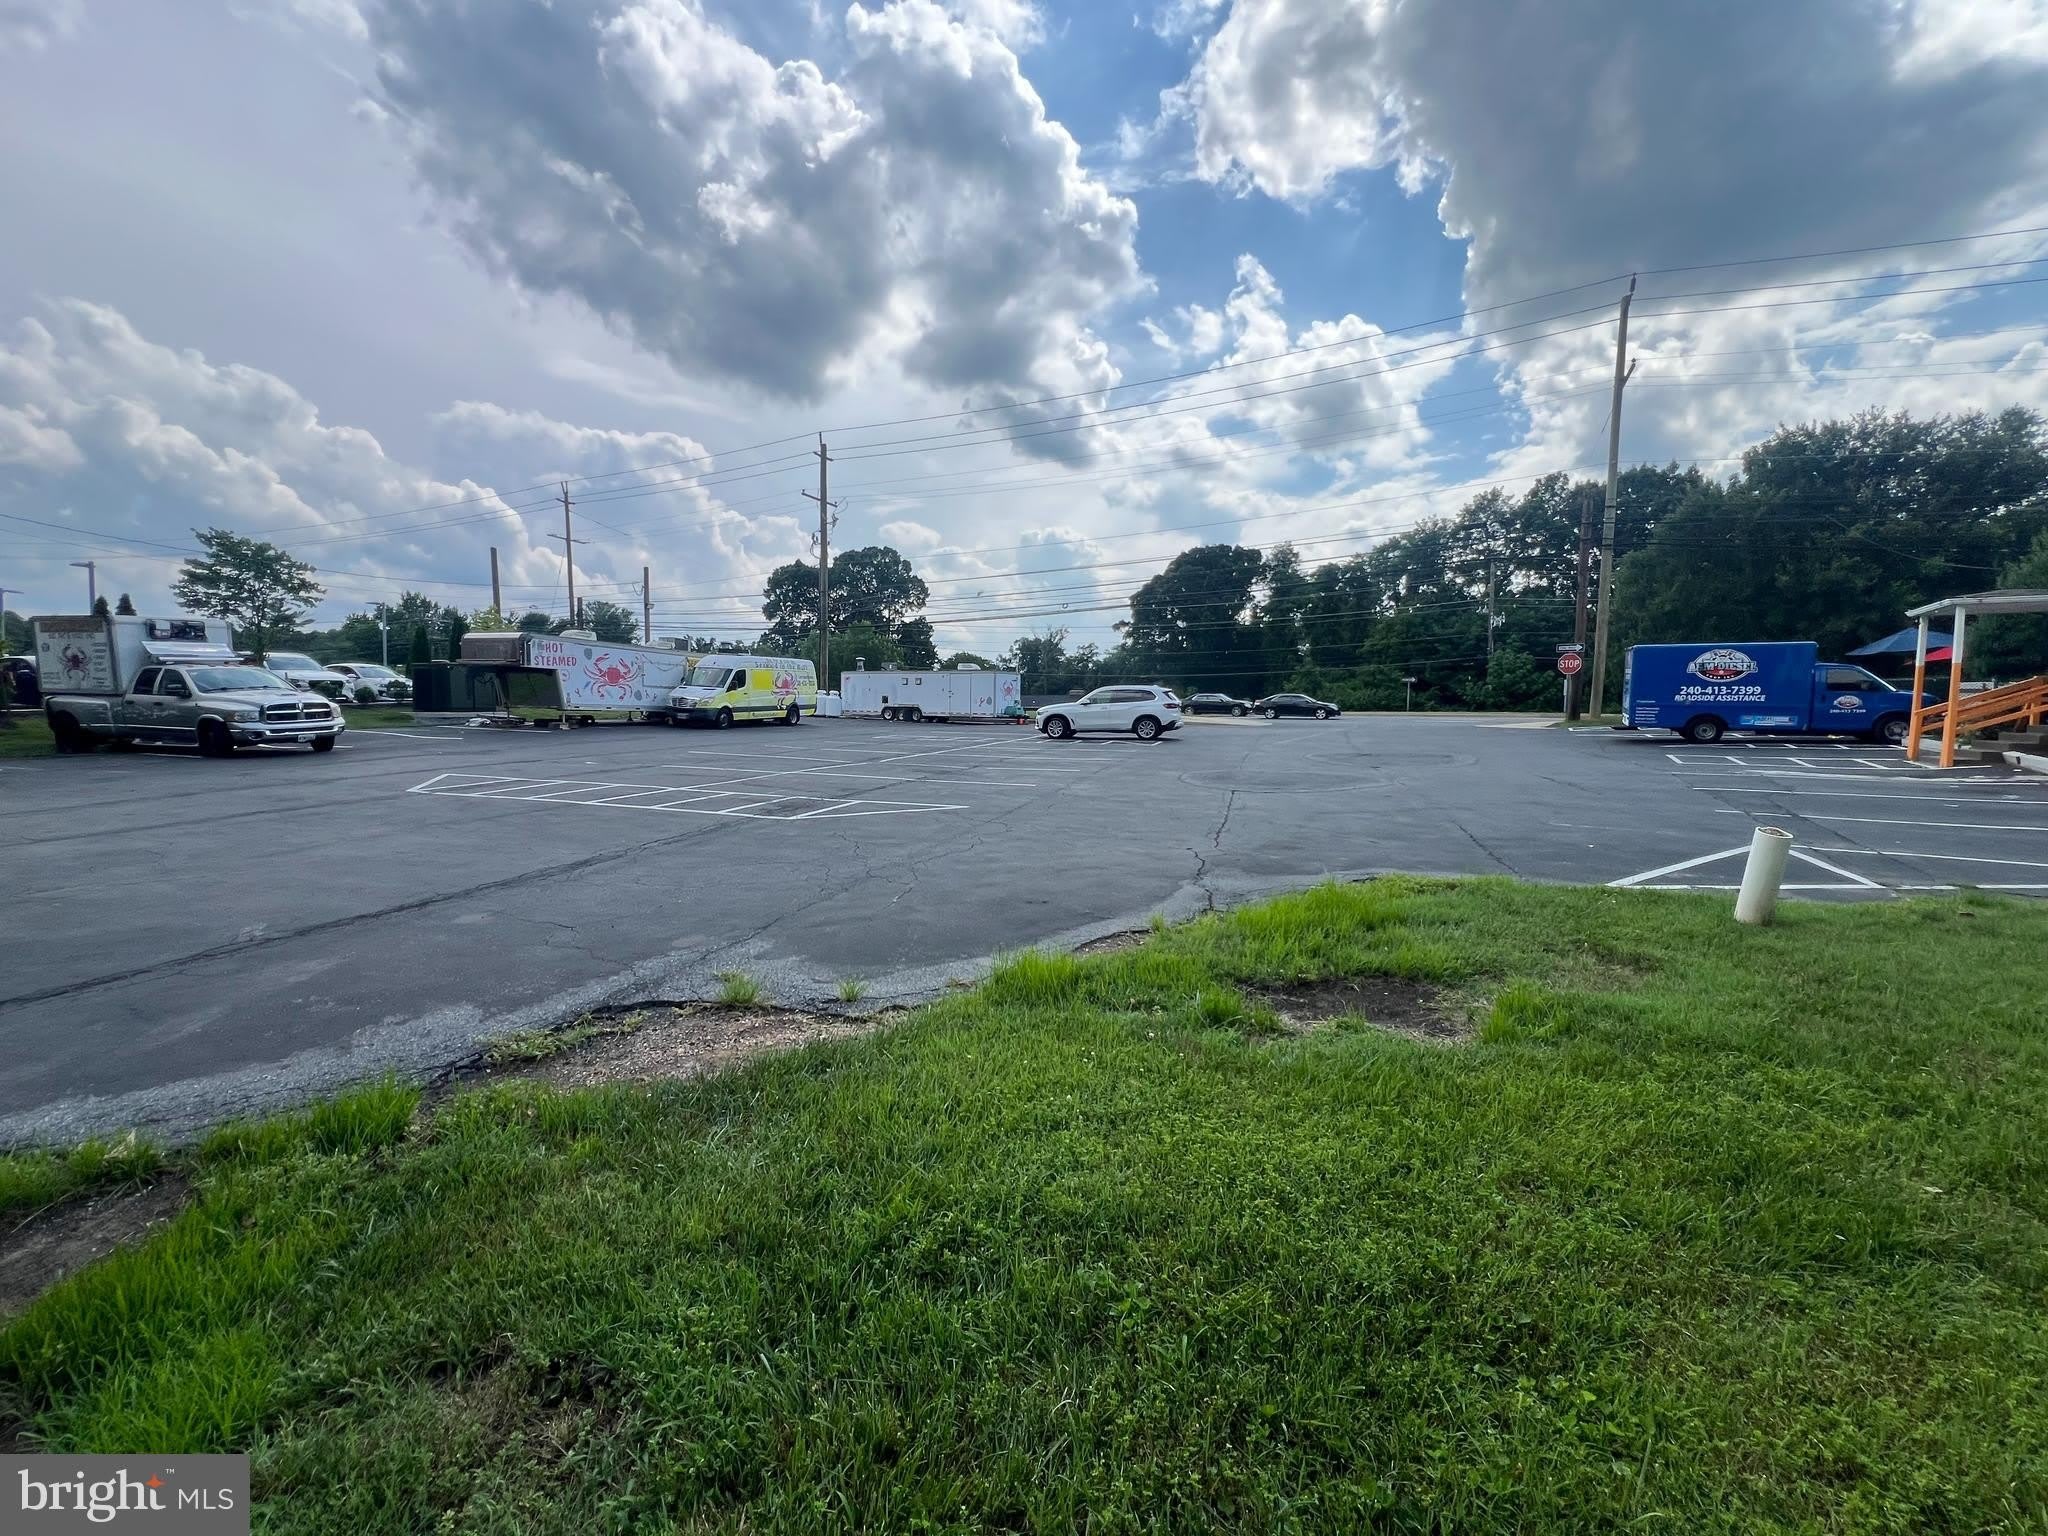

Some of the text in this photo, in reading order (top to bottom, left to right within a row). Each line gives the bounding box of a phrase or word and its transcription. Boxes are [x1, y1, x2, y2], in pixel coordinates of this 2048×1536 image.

[545, 642, 564, 653] HOT
[534, 655, 577, 667] STEAMED
[1560, 660, 1580, 668] STOP
[1717, 661, 1758, 673] DIESEL
[1680, 686, 1761, 695] 240-413-7399
